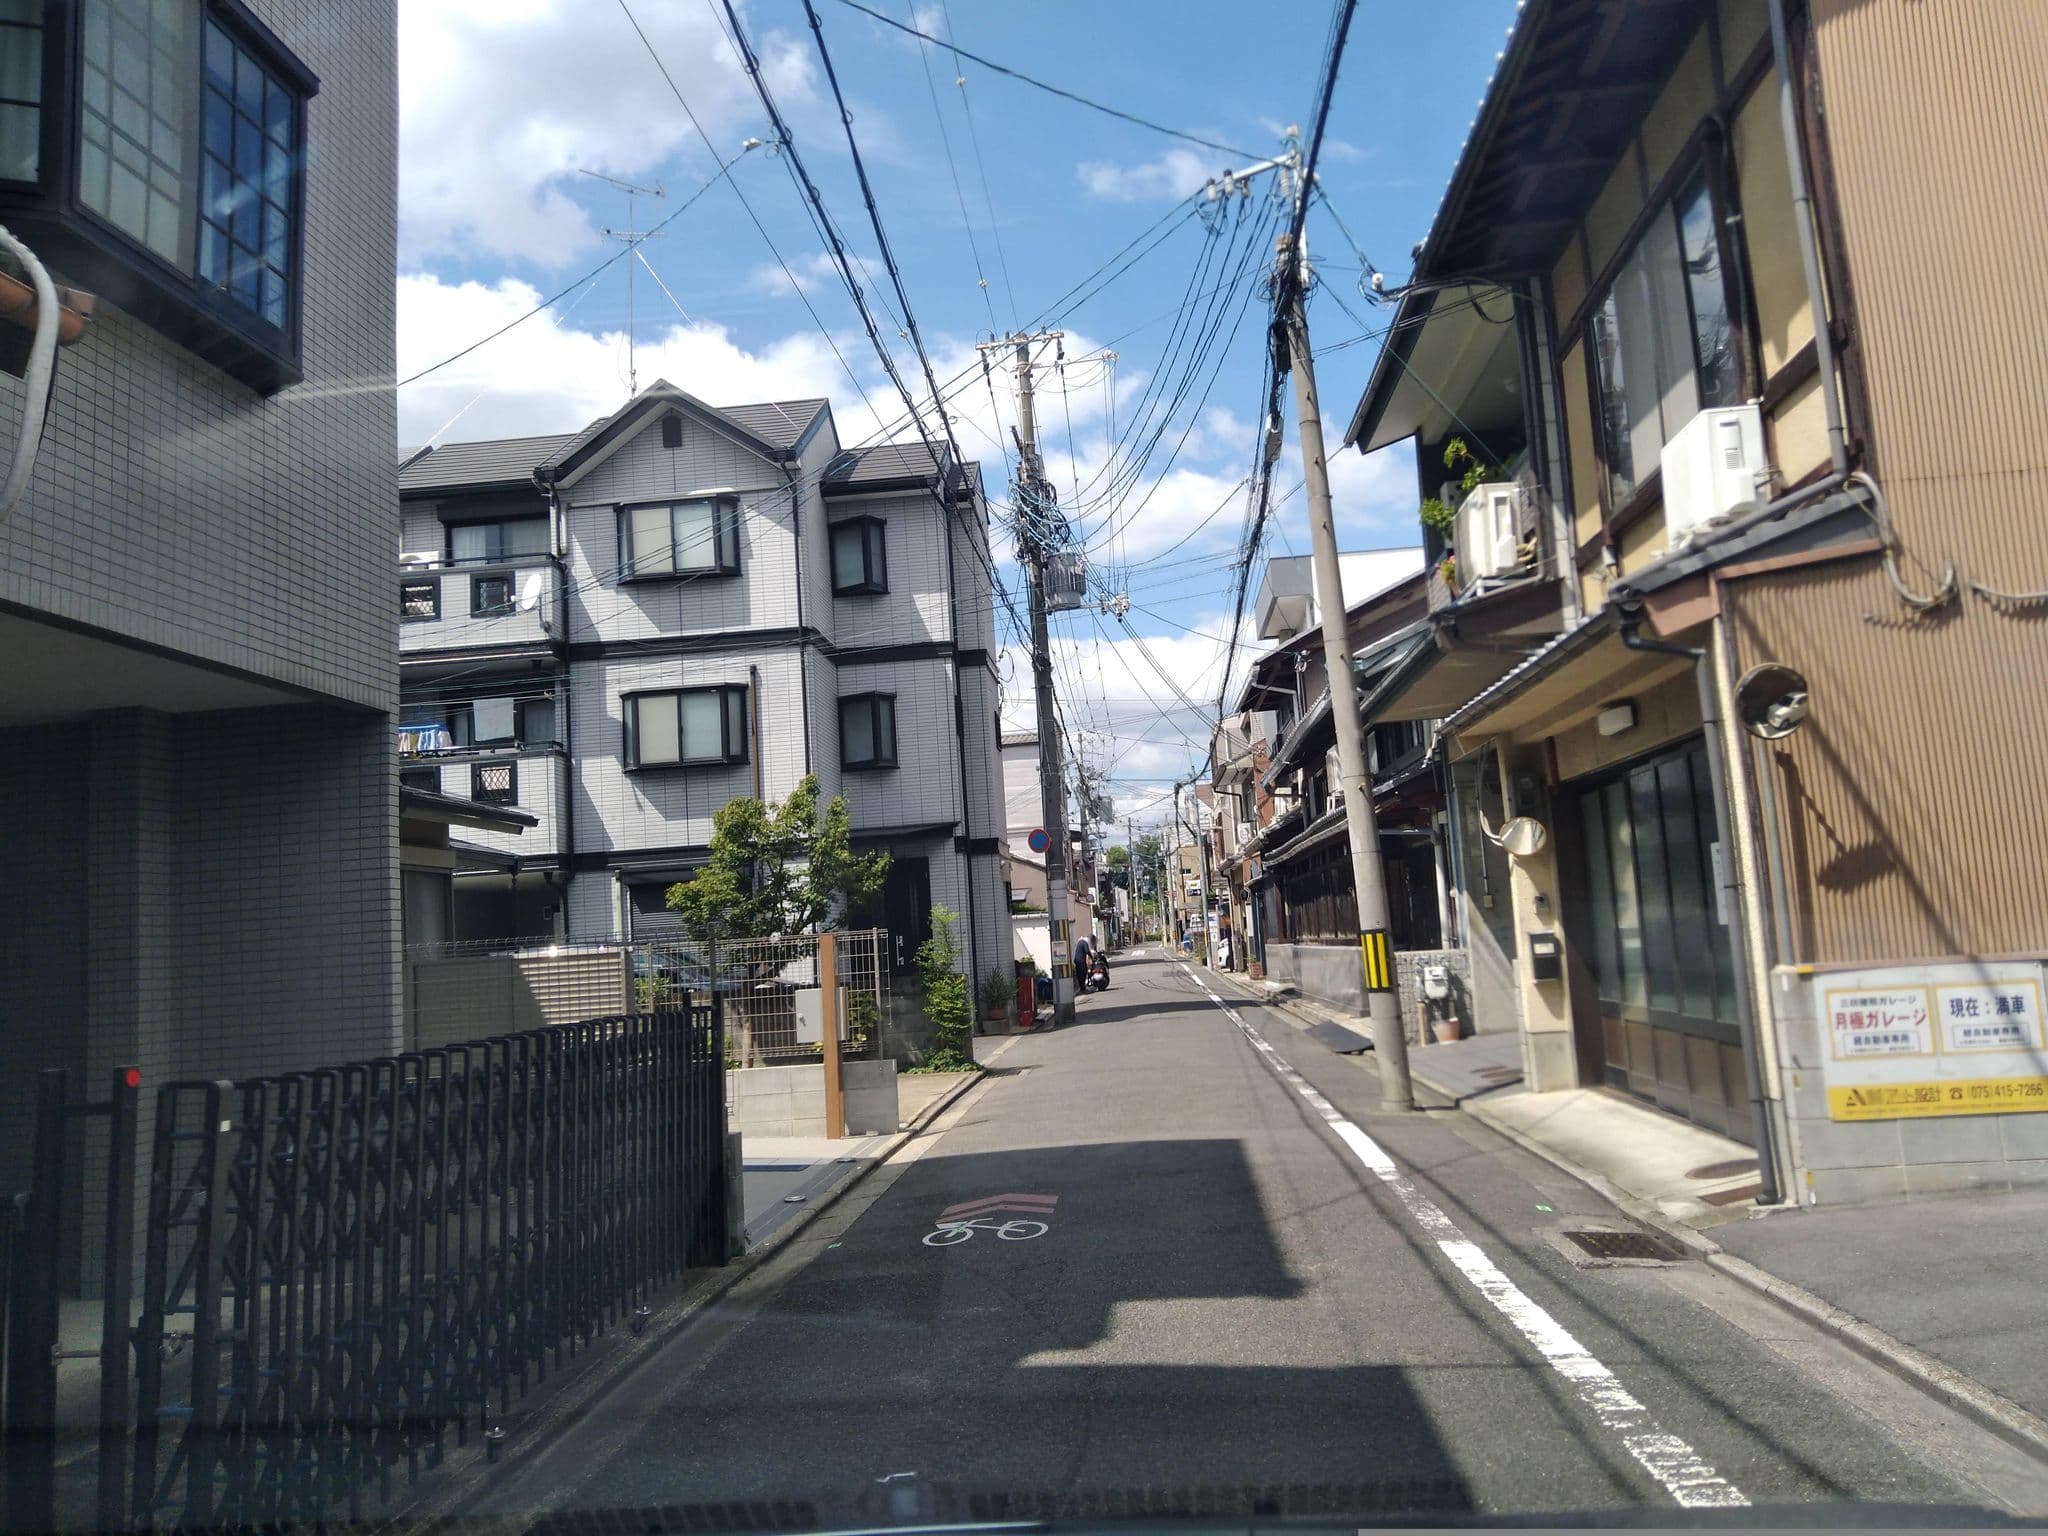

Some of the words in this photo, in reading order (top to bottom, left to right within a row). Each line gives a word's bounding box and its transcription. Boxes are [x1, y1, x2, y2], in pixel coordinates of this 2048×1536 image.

[1835, 1008, 1927, 1030] 月極ガレージ
